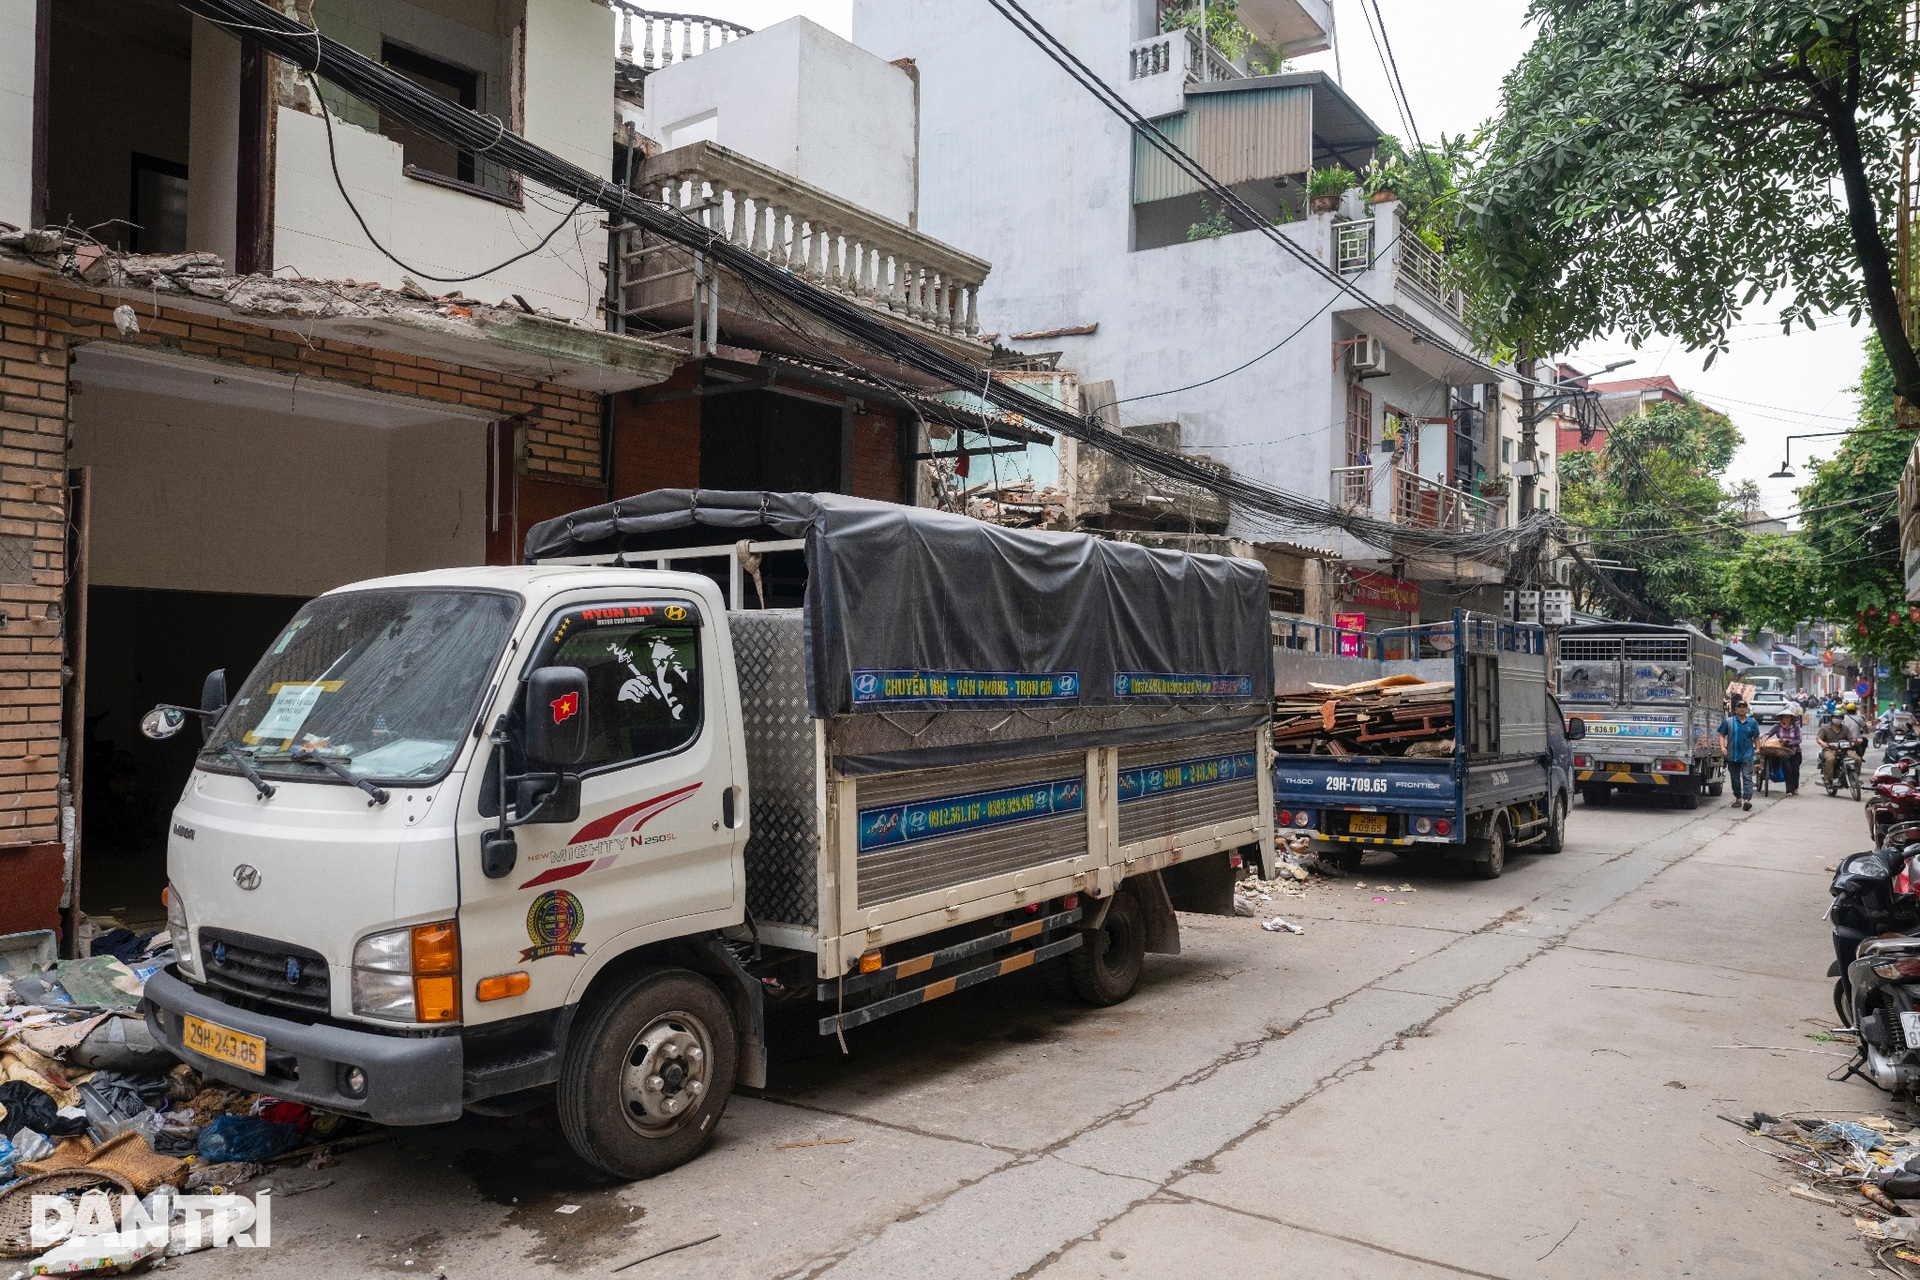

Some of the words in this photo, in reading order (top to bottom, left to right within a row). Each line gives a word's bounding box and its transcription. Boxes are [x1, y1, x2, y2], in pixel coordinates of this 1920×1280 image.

[581, 607, 625, 621] HYUN
[627, 606, 654, 617] DAI
[884, 672, 928, 696] CHUYỂN
[929, 676, 948, 696] NHÀ
[956, 676, 976, 696] VĂN
[1015, 680, 1039, 698] TRỌN
[1163, 766, 1182, 788] 29H
[1285, 777, 1313, 785] THACO
[1326, 776, 1387, 793] 29H-709.65
[1395, 781, 1441, 790] FRONTIER
[1360, 816, 1377, 824] 29H
[1353, 824, 1382, 833] 709.65
[527, 852, 550, 862] NEW
[550, 837, 629, 864] MIGHTY
[190, 1023, 257, 1065] 29H-243.86
